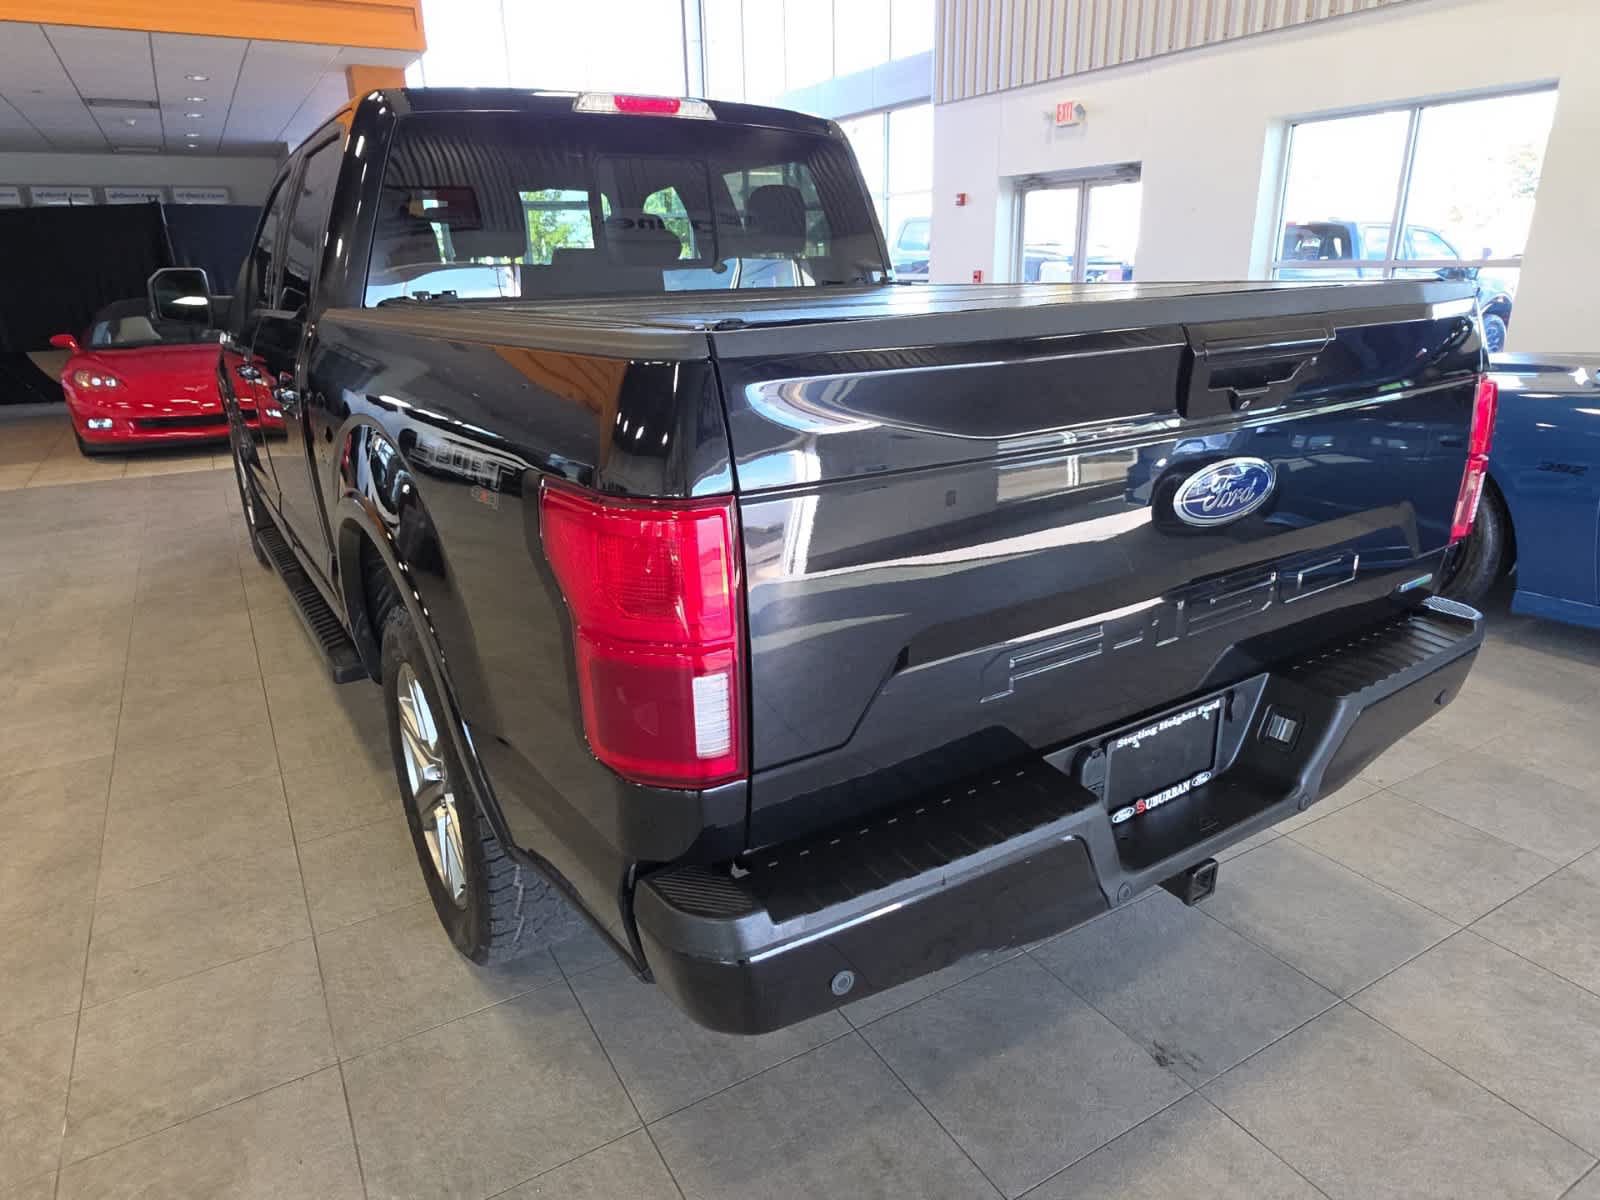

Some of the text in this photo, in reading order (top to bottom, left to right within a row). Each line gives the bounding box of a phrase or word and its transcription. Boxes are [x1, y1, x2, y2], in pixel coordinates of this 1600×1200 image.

[1056, 103, 1072, 121] EXIT
[1184, 473, 1257, 512] Ford
[981, 552, 1359, 703] F-150
[1158, 710, 1197, 731] Heights
[1135, 780, 1191, 815] SUBURBAN
